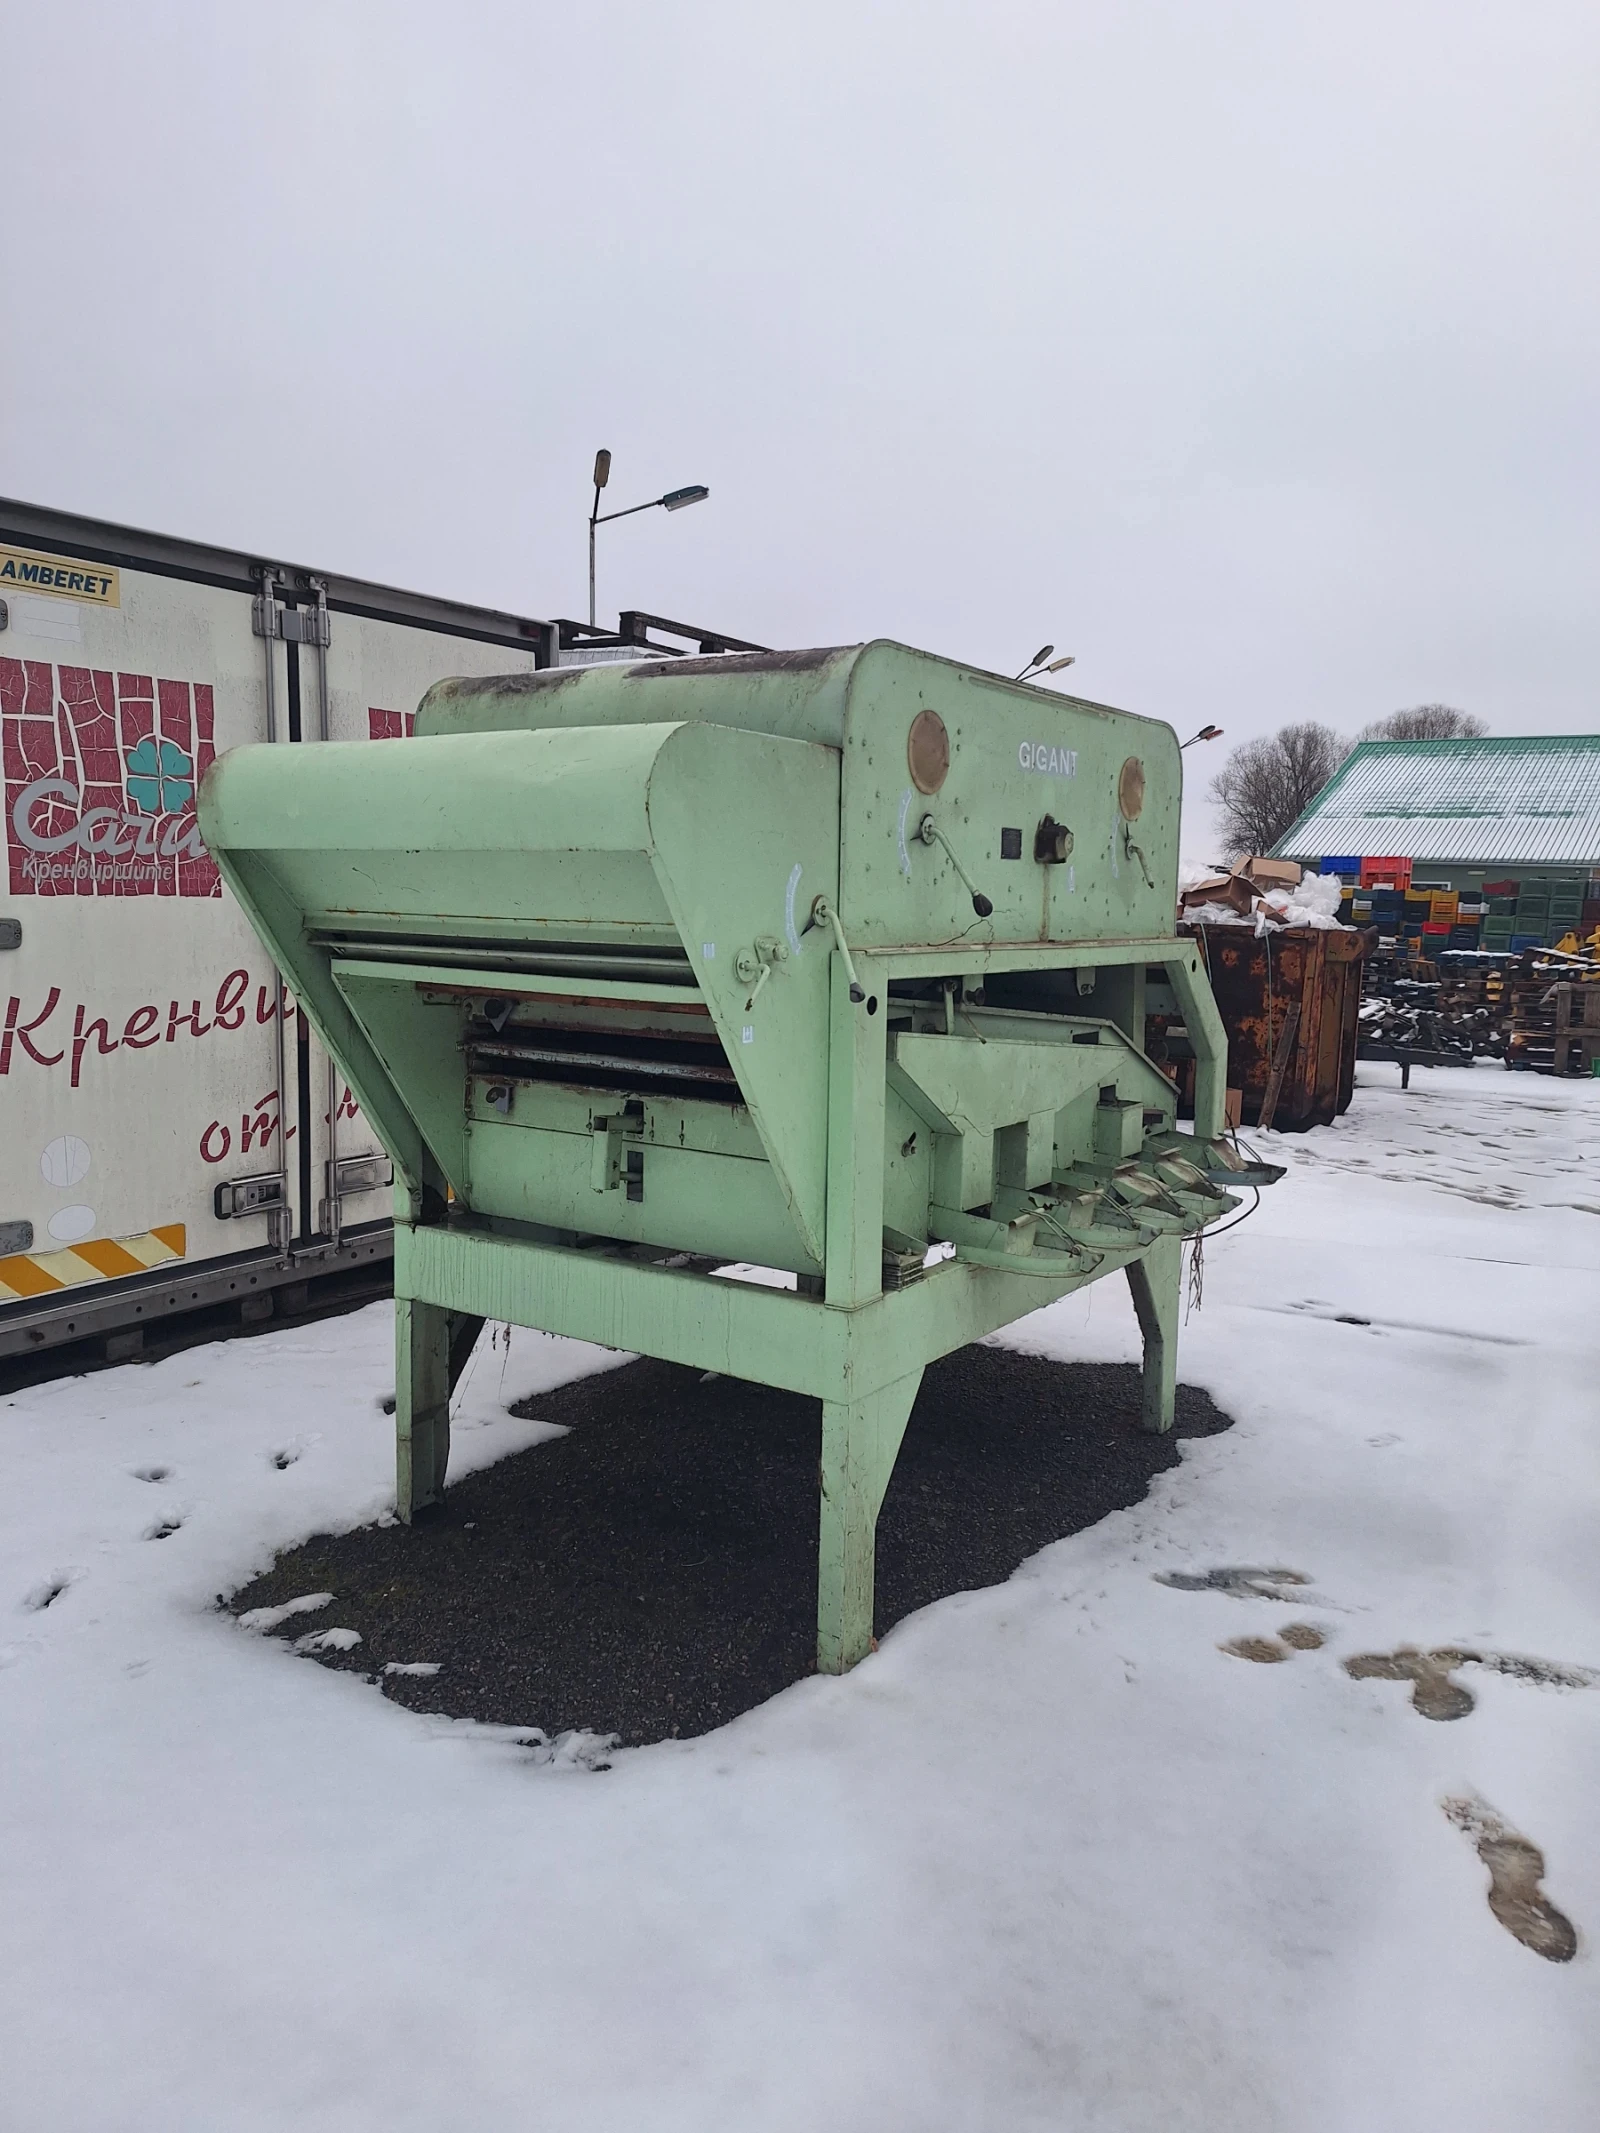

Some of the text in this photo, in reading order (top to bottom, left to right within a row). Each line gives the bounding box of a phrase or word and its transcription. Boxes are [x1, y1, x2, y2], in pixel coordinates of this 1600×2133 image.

[0, 560, 113, 596] AMBERET
[1018, 741, 1078, 776] GIGANT
[22, 857, 173, 885] Кренвиршите
[0, 969, 295, 1088] Кренви
[199, 1090, 296, 1163] от
